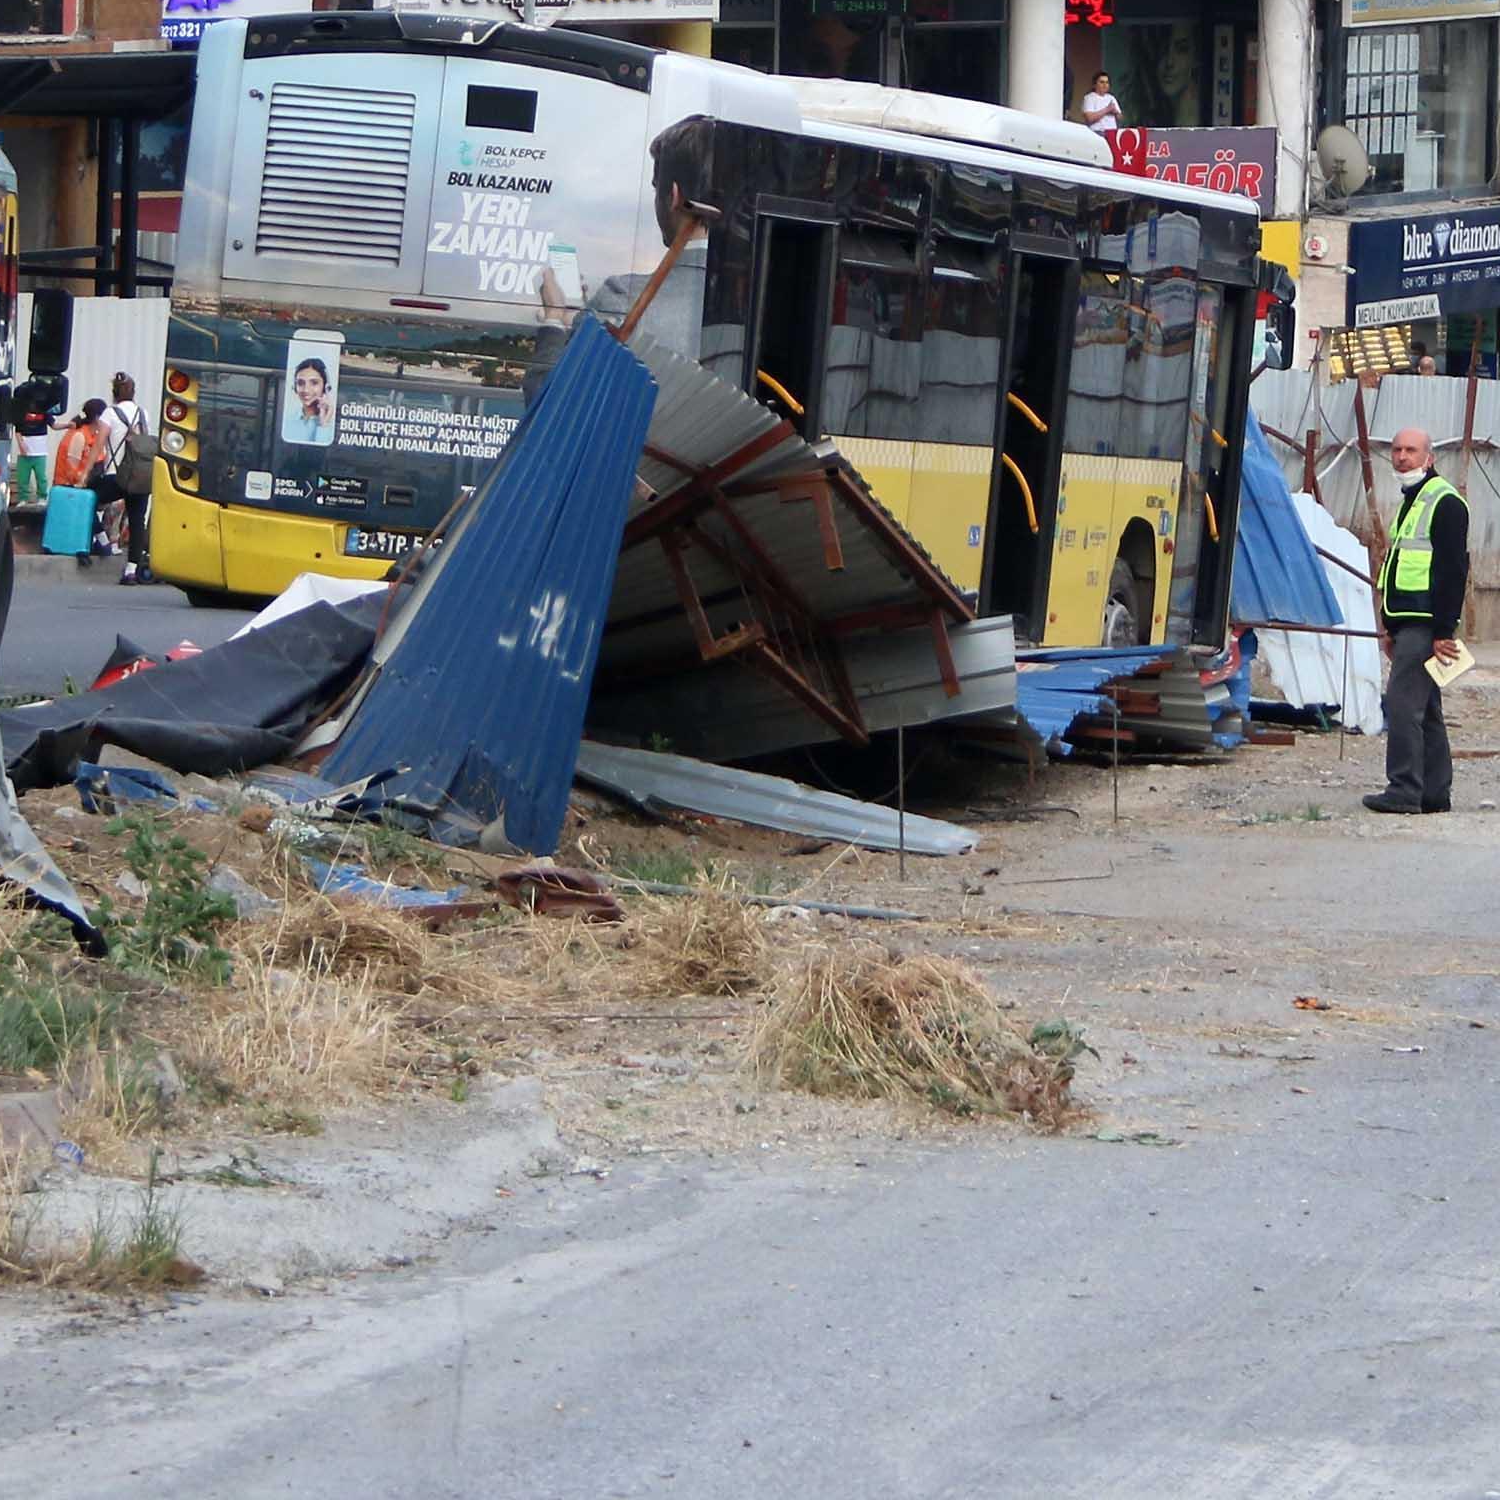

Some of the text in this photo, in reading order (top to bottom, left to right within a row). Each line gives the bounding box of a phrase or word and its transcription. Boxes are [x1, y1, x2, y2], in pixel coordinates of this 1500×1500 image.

[179, 22, 199, 37] 321
[480, 157, 516, 169] HESAP
[485, 145, 547, 161] BOL KEPÇE
[448, 171, 553, 194] BOL KAZANCIN
[462, 191, 532, 227] YERİ
[1403, 224, 1432, 261] blue
[478, 259, 543, 295] YOK
[341, 403, 406, 421] GÖRÜNTÜLÜ
[408, 408, 480, 429] GÖRÜŞMEYLE
[340, 418, 511, 445] BOL KEPÇE HESAP AÇARAK BİRİ
[338, 432, 502, 459] AVANTAJLI ORANLARLA DEĞER
